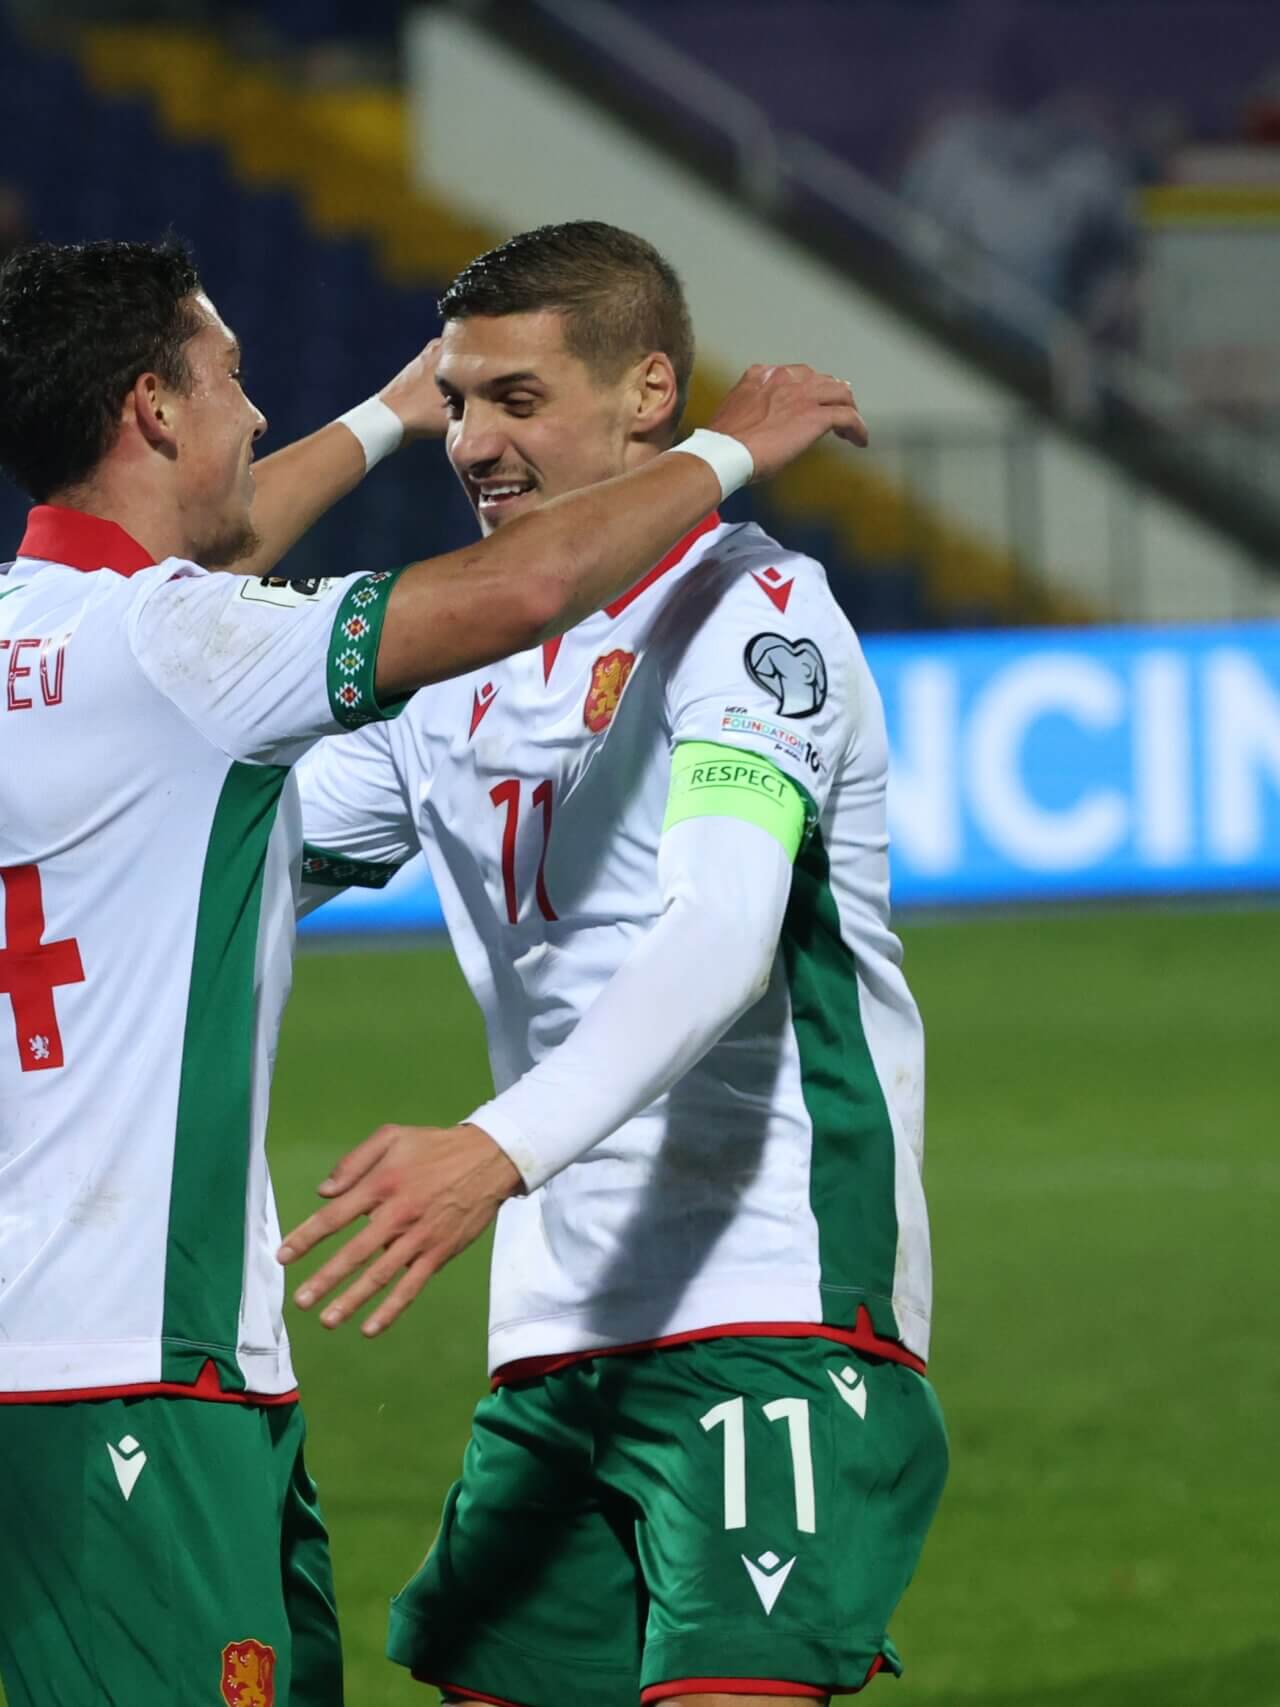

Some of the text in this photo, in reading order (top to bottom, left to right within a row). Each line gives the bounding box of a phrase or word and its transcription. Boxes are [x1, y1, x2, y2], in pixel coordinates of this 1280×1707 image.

[721, 717, 805, 752] FOUNDATION
[691, 766, 788, 798] RESPECT
[489, 779, 559, 925] 11
[699, 1396, 816, 1534] 11
